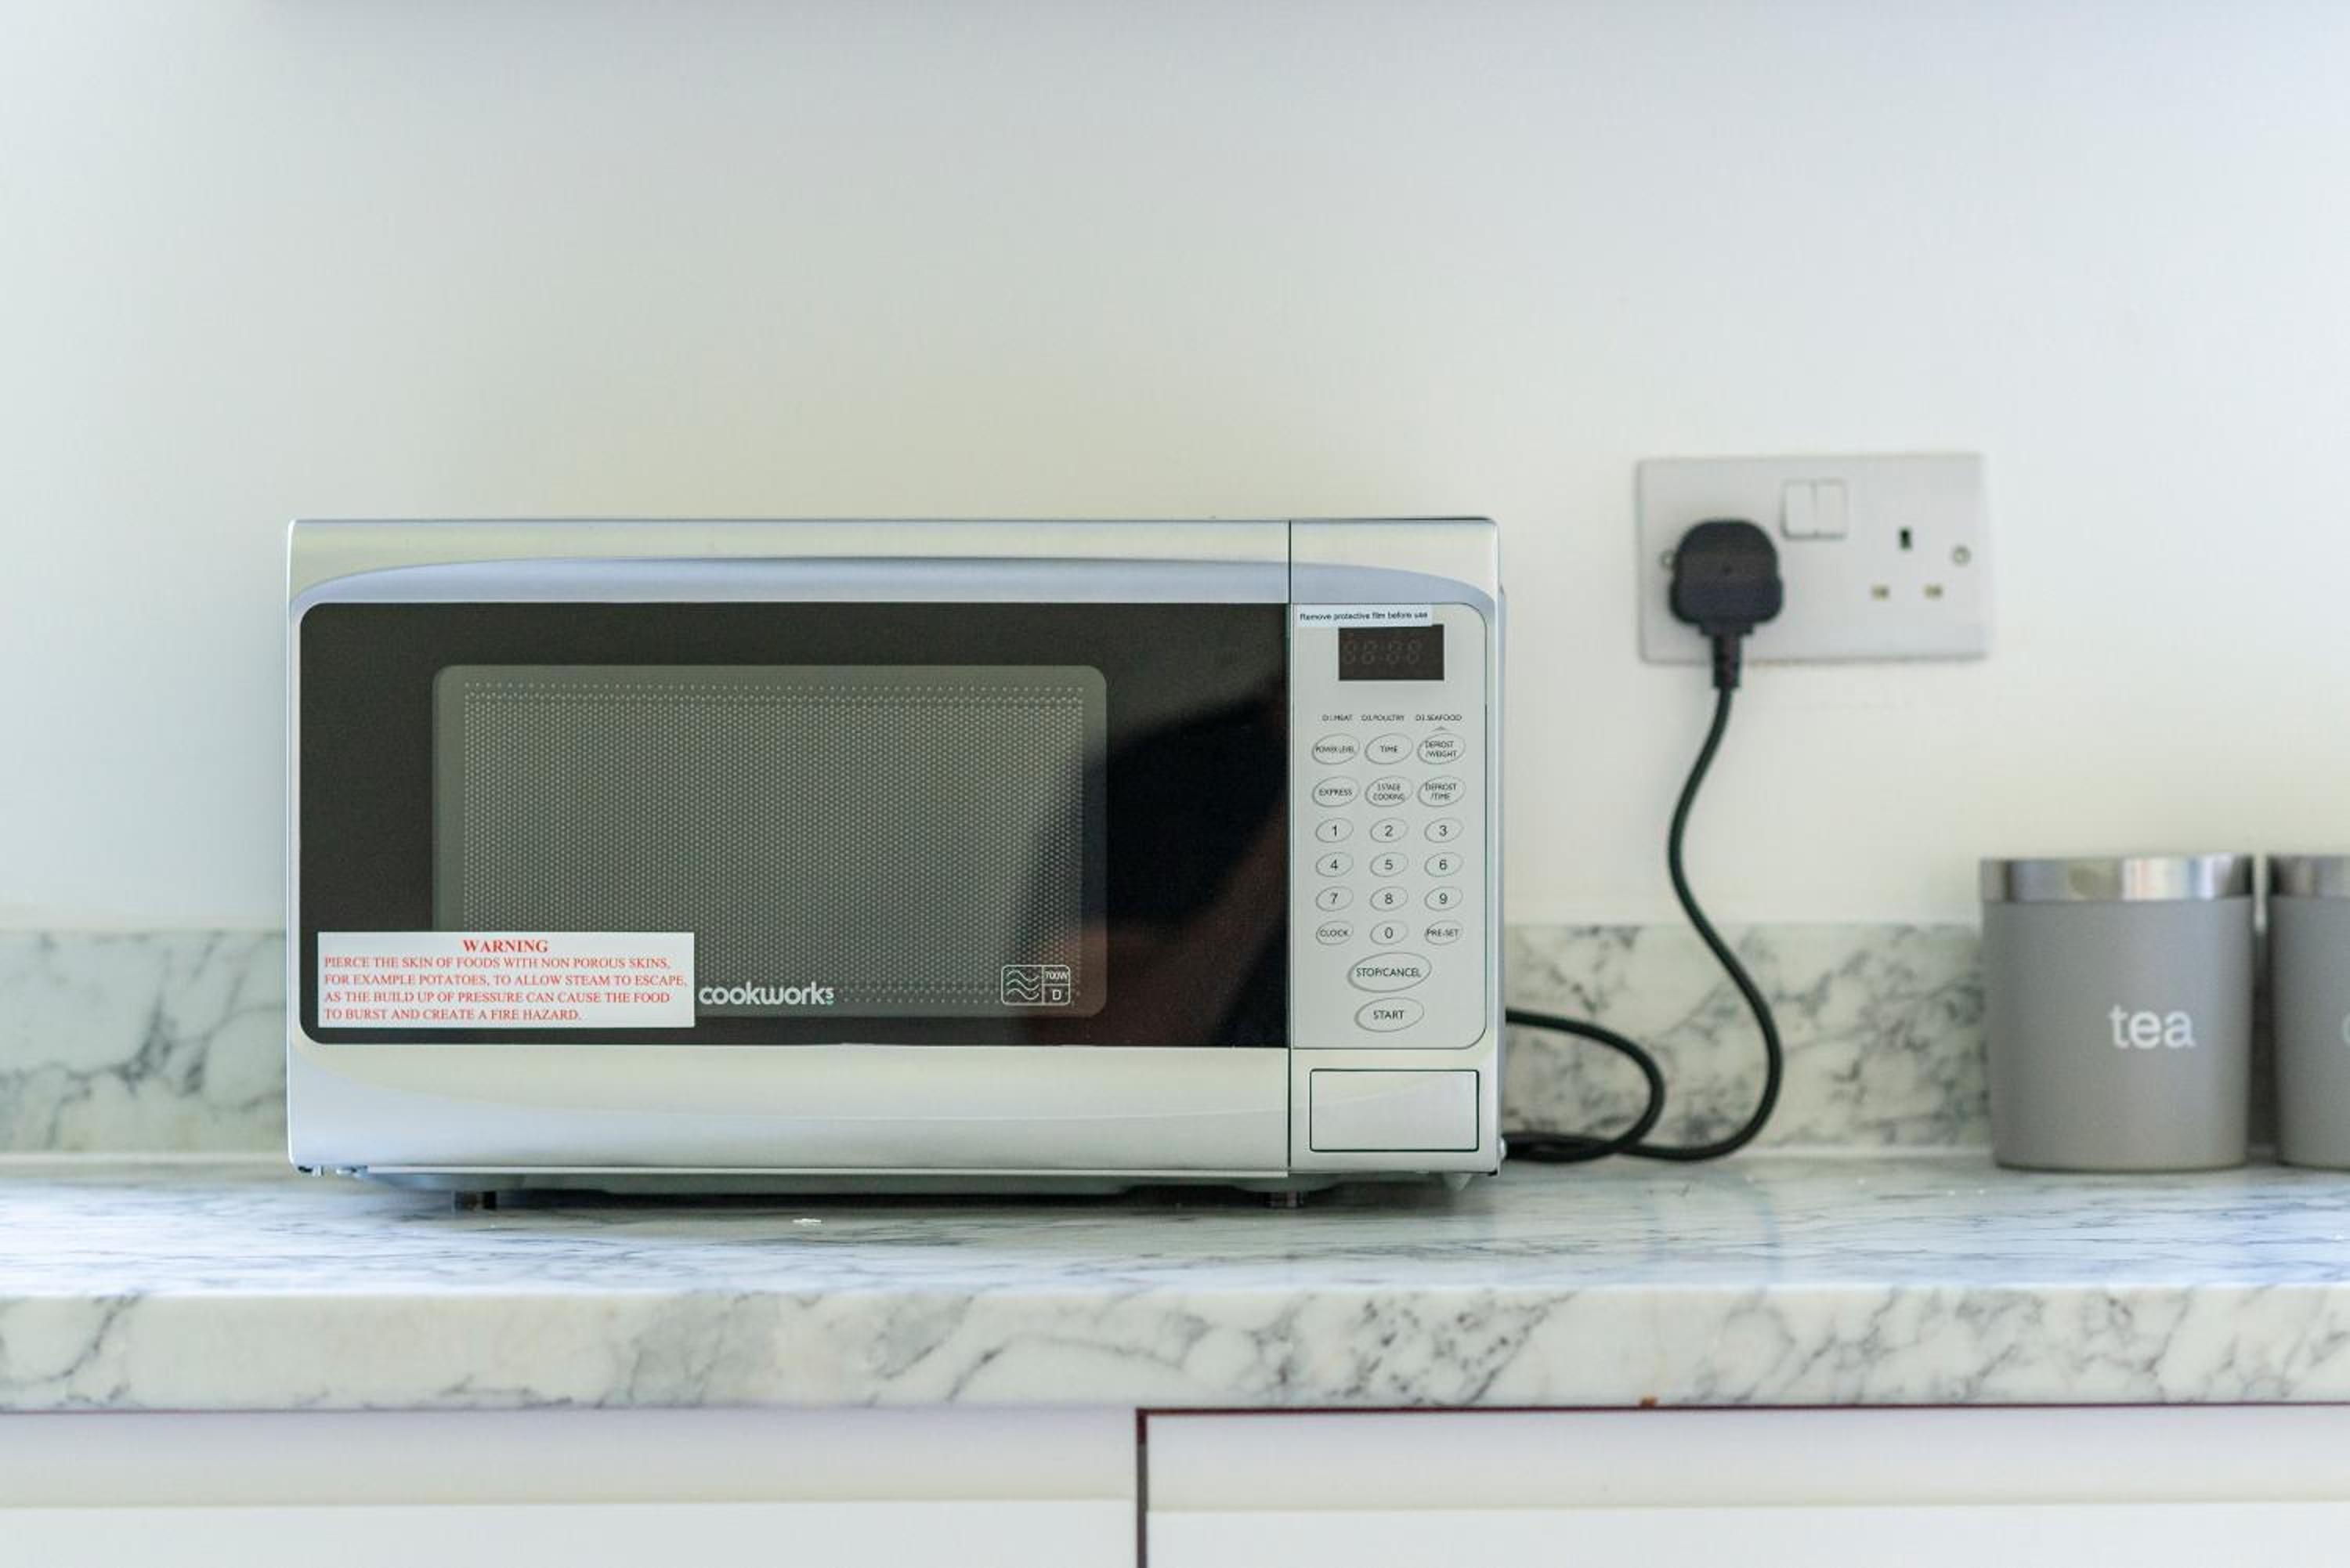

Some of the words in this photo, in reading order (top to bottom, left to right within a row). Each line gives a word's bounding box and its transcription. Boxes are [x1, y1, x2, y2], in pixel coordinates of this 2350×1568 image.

[1333, 612, 1370, 621] protective
[1425, 782, 1457, 791] DEFROST
[1372, 793, 1405, 801] COOKING
[1330, 825, 1338, 837] 1
[1384, 825, 1394, 837] 2
[1439, 825, 1448, 837] 3
[1330, 859, 1338, 871] 4
[1384, 859, 1394, 871] 5
[1439, 859, 1448, 871] 6
[1330, 893, 1338, 904] 7
[1384, 893, 1394, 904] 8
[1439, 893, 1448, 904] 9
[1320, 929, 1349, 938] CLOCK
[1384, 927, 1394, 939] 0
[1426, 928, 1459, 938] PRE-SET
[463, 939, 548, 953] WARNING
[325, 957, 370, 968] PIERCE
[374, 957, 399, 968] THE
[402, 957, 433, 968] SKIN
[436, 957, 453, 968] OF
[457, 957, 501, 968] FOODS
[504, 957, 538, 968] WITH
[541, 957, 570, 968] NON
[573, 957, 626, 968] POROUS
[1046, 970, 1068, 980] 700W
[1356, 967, 1422, 978] STOP/CANCEL
[325, 974, 349, 985] FOR
[353, 974, 416, 985] EXAMPLE
[419, 974, 490, 987] POTATOES,
[494, 974, 512, 985] TO
[515, 974, 562, 985] ALLOW
[565, 974, 610, 985] STEAM
[614, 974, 632, 985] TO
[325, 992, 341, 1003] AS
[345, 992, 374, 1003] THE
[374, 992, 414, 1003] BUILD
[417, 992, 434, 1003] UP
[437, 992, 454, 1003] OF
[458, 992, 523, 1003] PRESSURE
[526, 992, 555, 1003] CAN
[557, 992, 602, 1003] CAUSE
[605, 992, 631, 1003] THE
[633, 992, 671, 1003] FOOD
[698, 981, 835, 1006] cookworks
[325, 1009, 342, 1020] TO
[345, 1009, 389, 1020] BURST
[392, 1009, 421, 1020] AND
[422, 1009, 474, 1020] CREATE
[478, 1009, 487, 1020] A
[490, 1009, 519, 1020] FIRE
[522, 1009, 582, 1020] HAZARD.
[1373, 1010, 1405, 1020] START
[2108, 1003, 2196, 1050] tea
